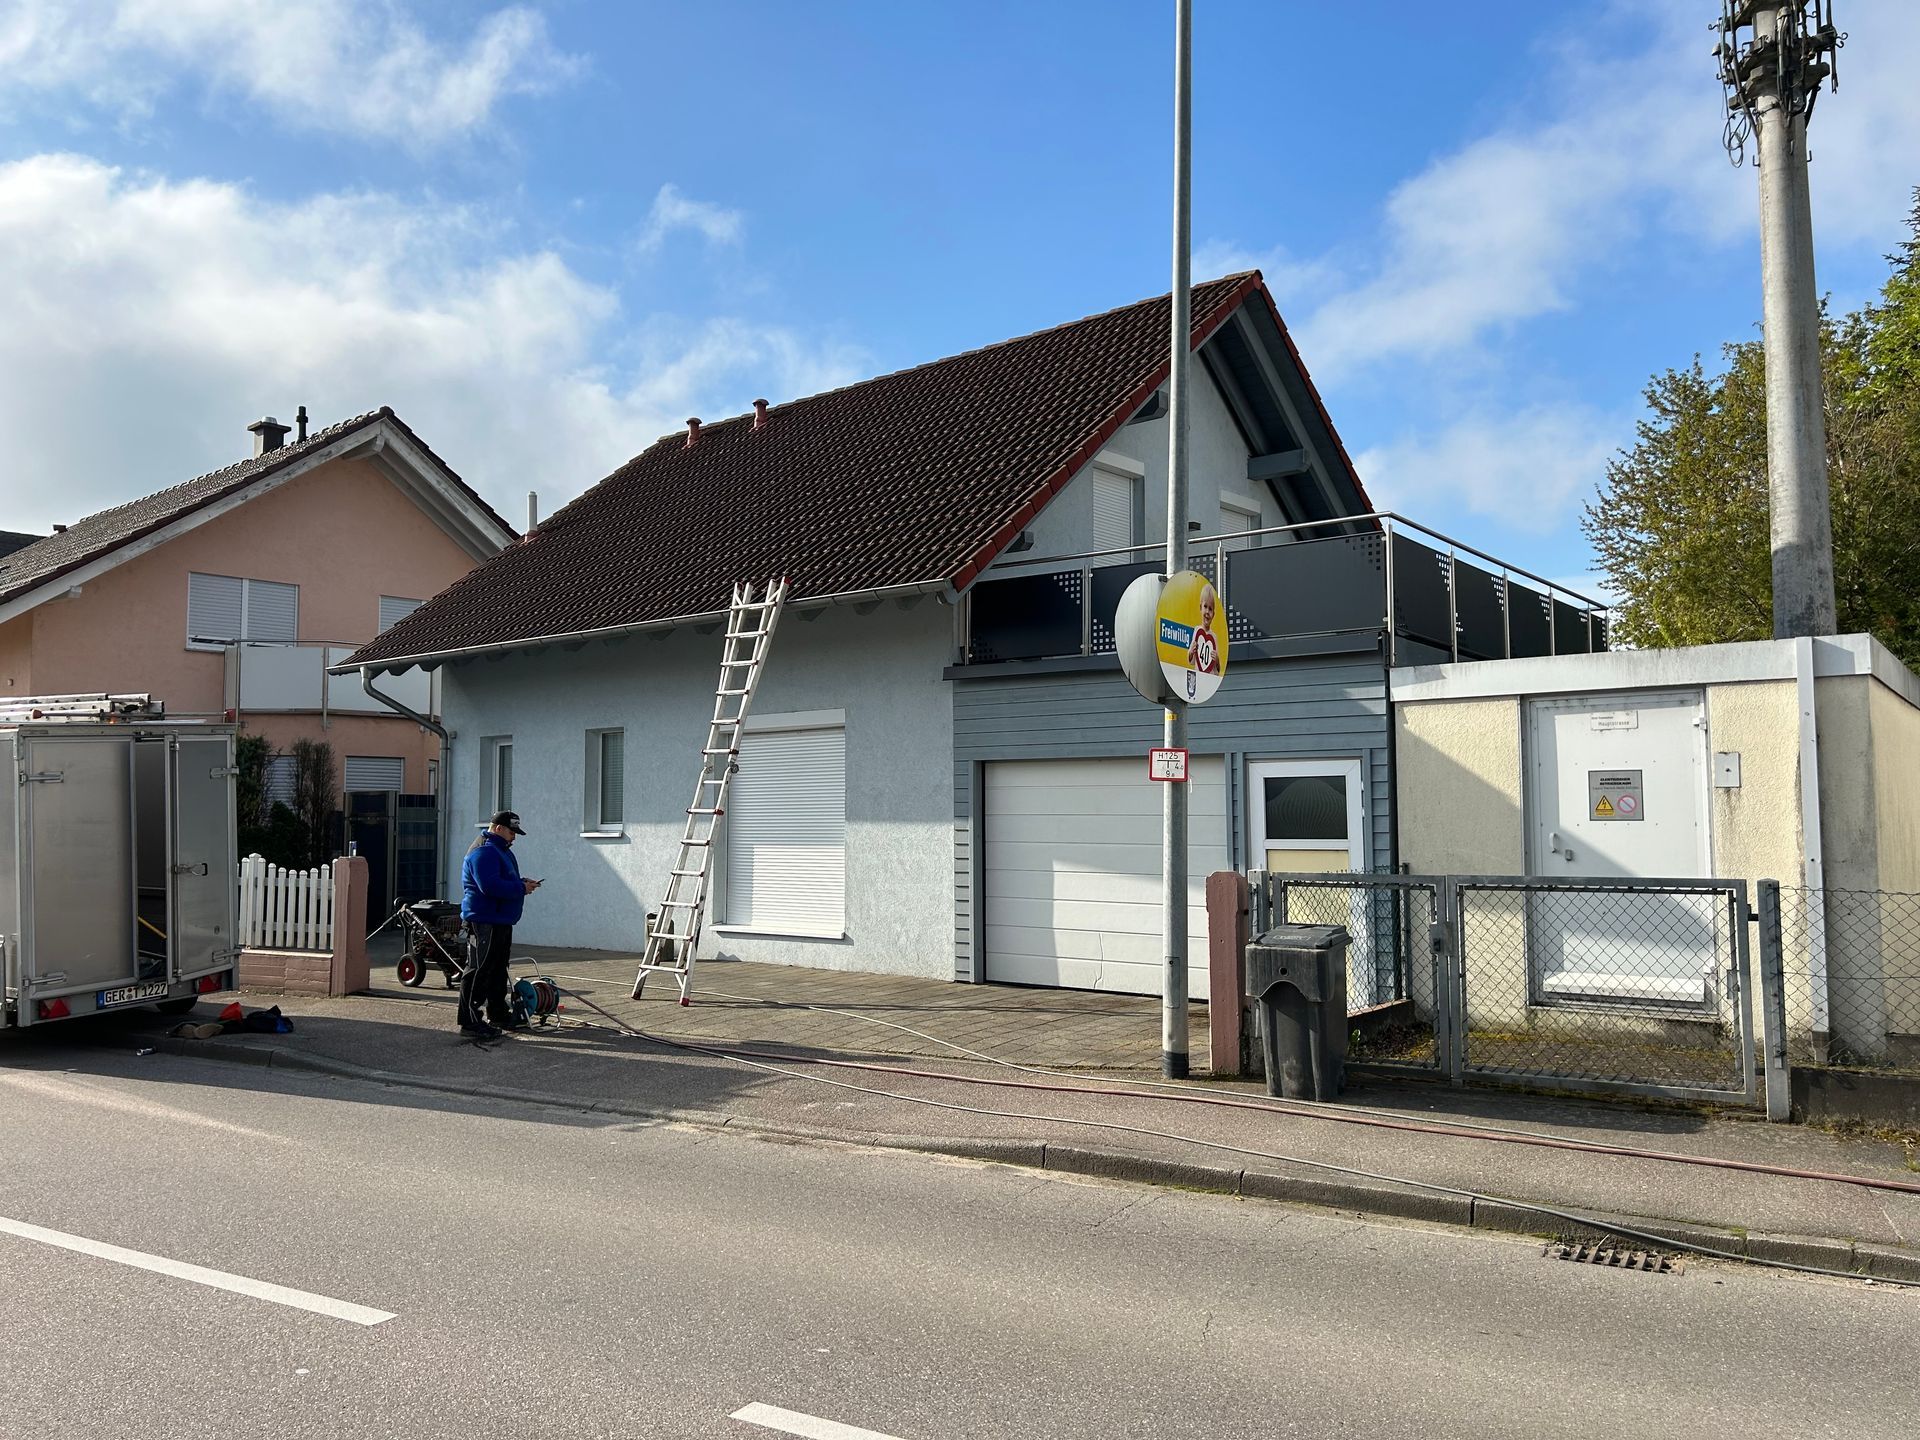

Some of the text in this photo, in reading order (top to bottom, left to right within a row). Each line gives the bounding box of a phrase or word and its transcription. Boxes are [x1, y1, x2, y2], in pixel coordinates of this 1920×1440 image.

[1161, 622, 1190, 648] Freiwillig
[1199, 642, 1210, 666] 40
[105, 983, 166, 1003] GER T 1227
